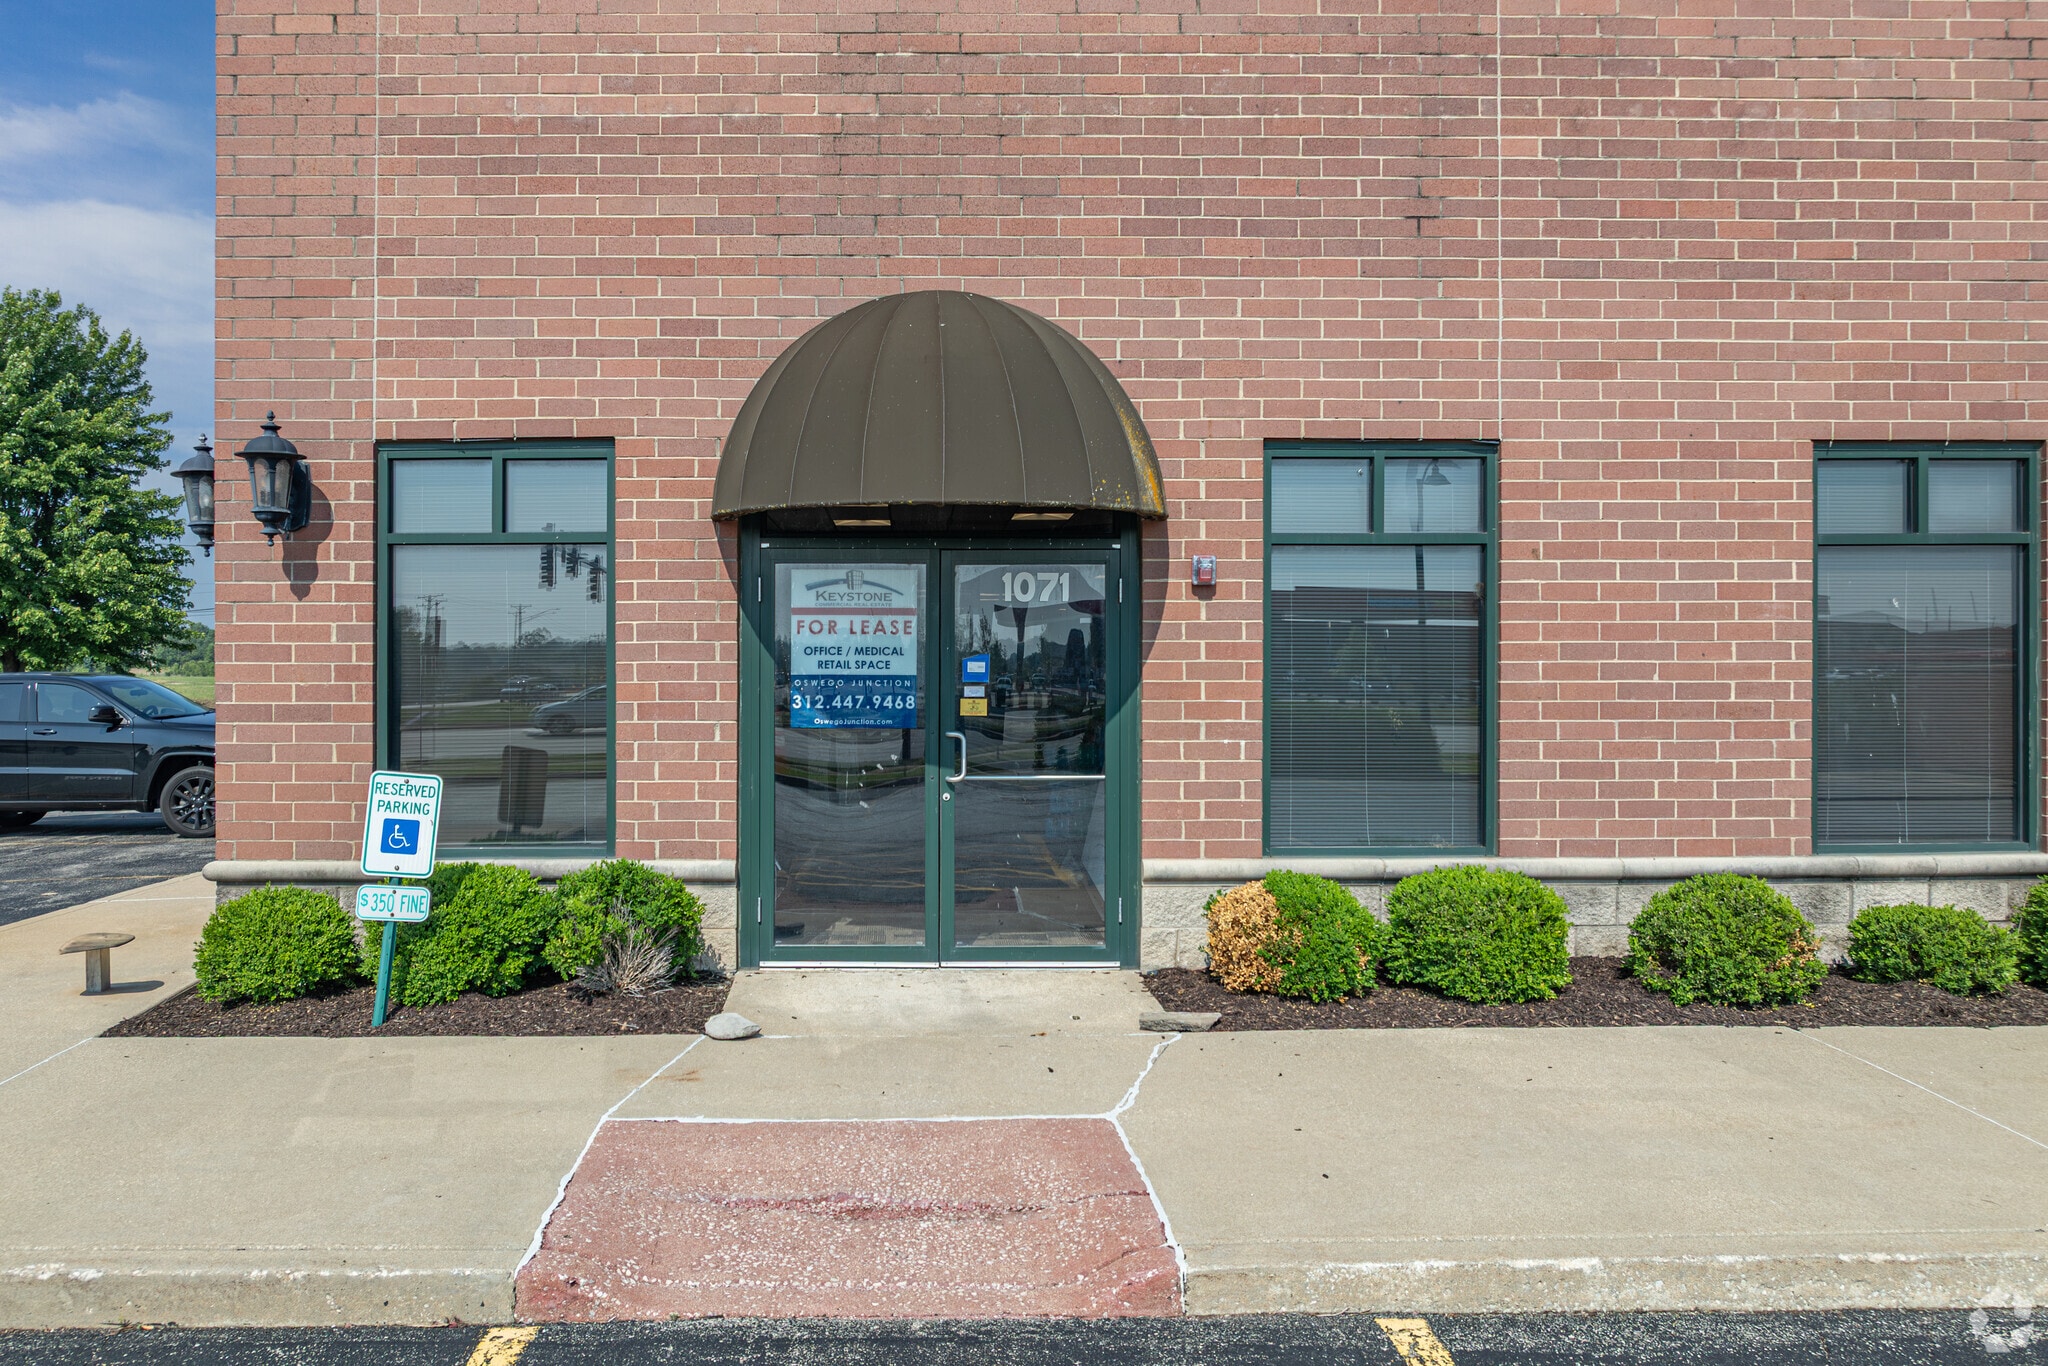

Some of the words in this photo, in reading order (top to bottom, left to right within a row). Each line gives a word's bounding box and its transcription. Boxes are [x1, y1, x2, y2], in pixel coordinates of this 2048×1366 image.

[1001, 571, 1070, 602] 1071
[815, 590, 893, 602] KEYSTONE
[796, 620, 838, 635] FOR
[850, 620, 913, 635] LEASE
[803, 646, 843, 656] OFFICE
[845, 646, 851, 657] /
[854, 646, 905, 656] MEDICAL
[817, 660, 852, 670] RETAIL
[854, 660, 891, 670] SPACE
[794, 679, 845, 687] OSWEGO
[851, 679, 912, 687] JUNCTION
[792, 695, 916, 709] 312.447.9468
[813, 717, 893, 725] OswegoJunction.com
[374, 781, 436, 799] RESERVED
[377, 799, 431, 816] PARKING
[399, 894, 427, 914] FINE
